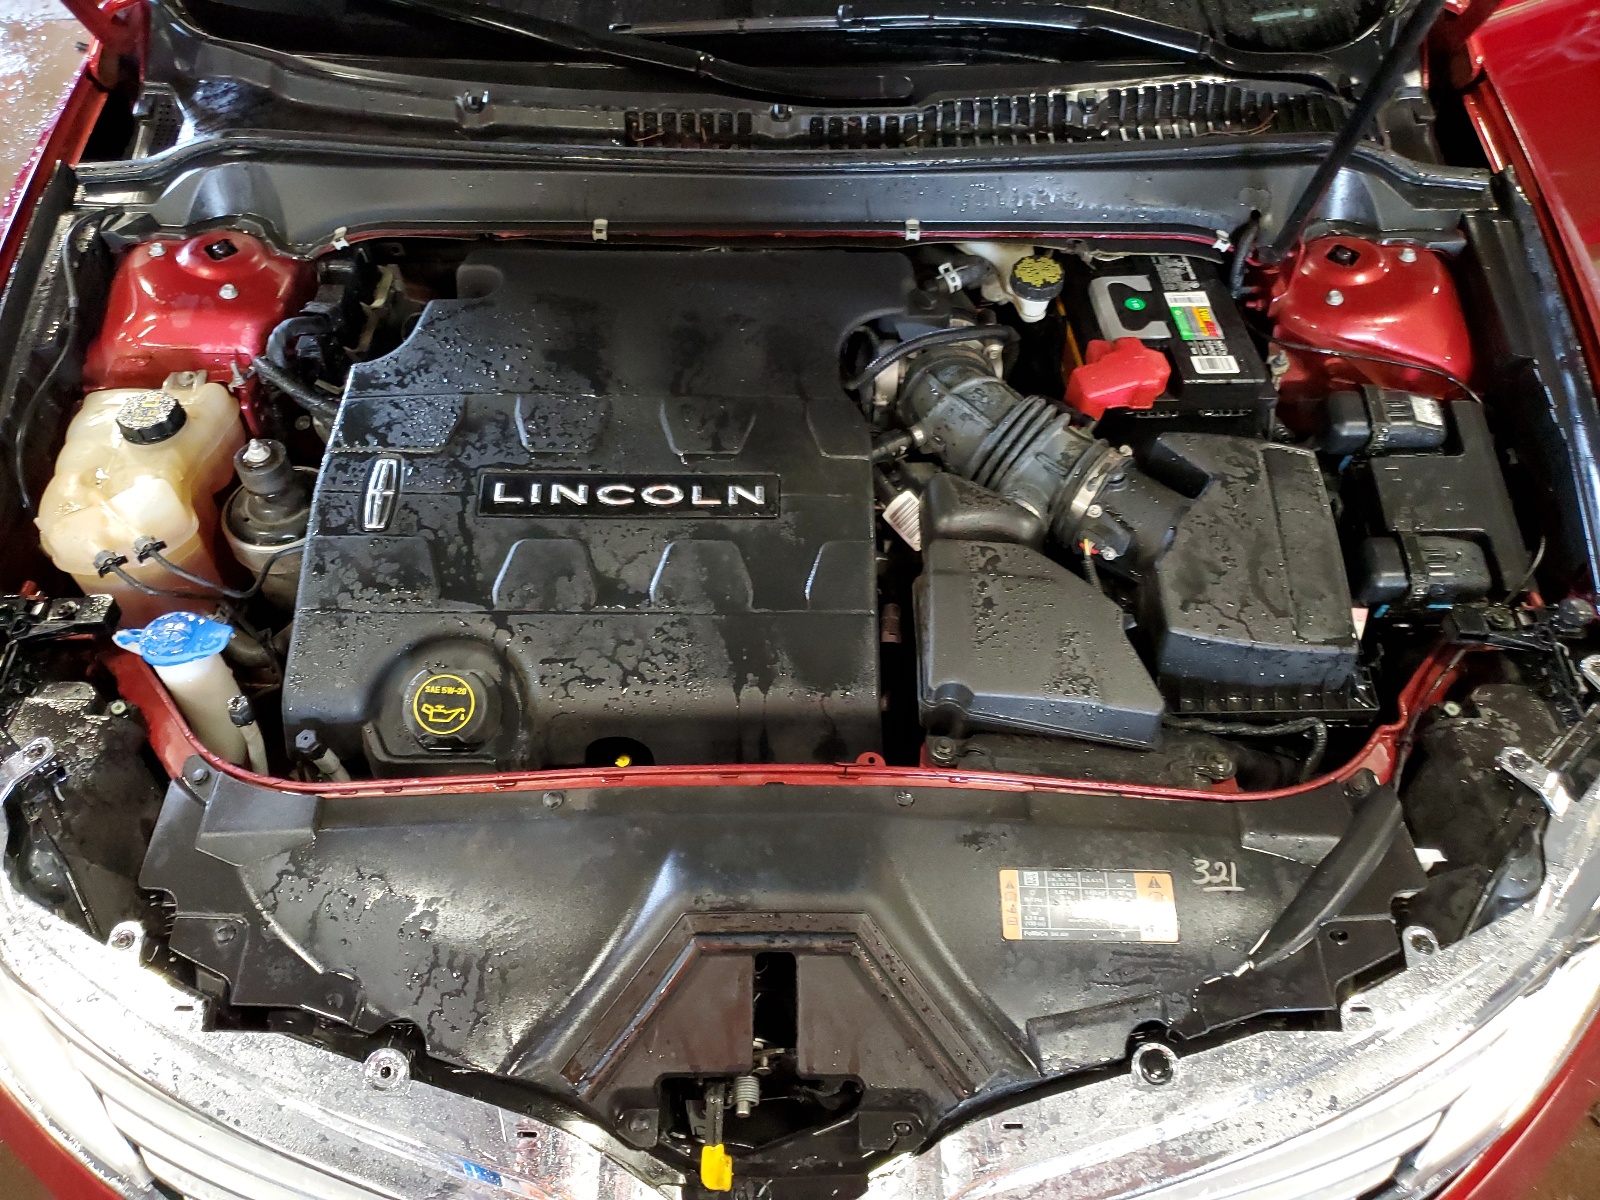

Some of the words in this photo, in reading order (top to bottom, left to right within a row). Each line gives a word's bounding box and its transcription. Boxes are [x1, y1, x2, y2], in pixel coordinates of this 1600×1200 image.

[493, 482, 765, 506] LINCOLN
[425, 685, 440, 694] SAE
[441, 686, 467, 695] 5W-20
[1191, 857, 1237, 888] 321
